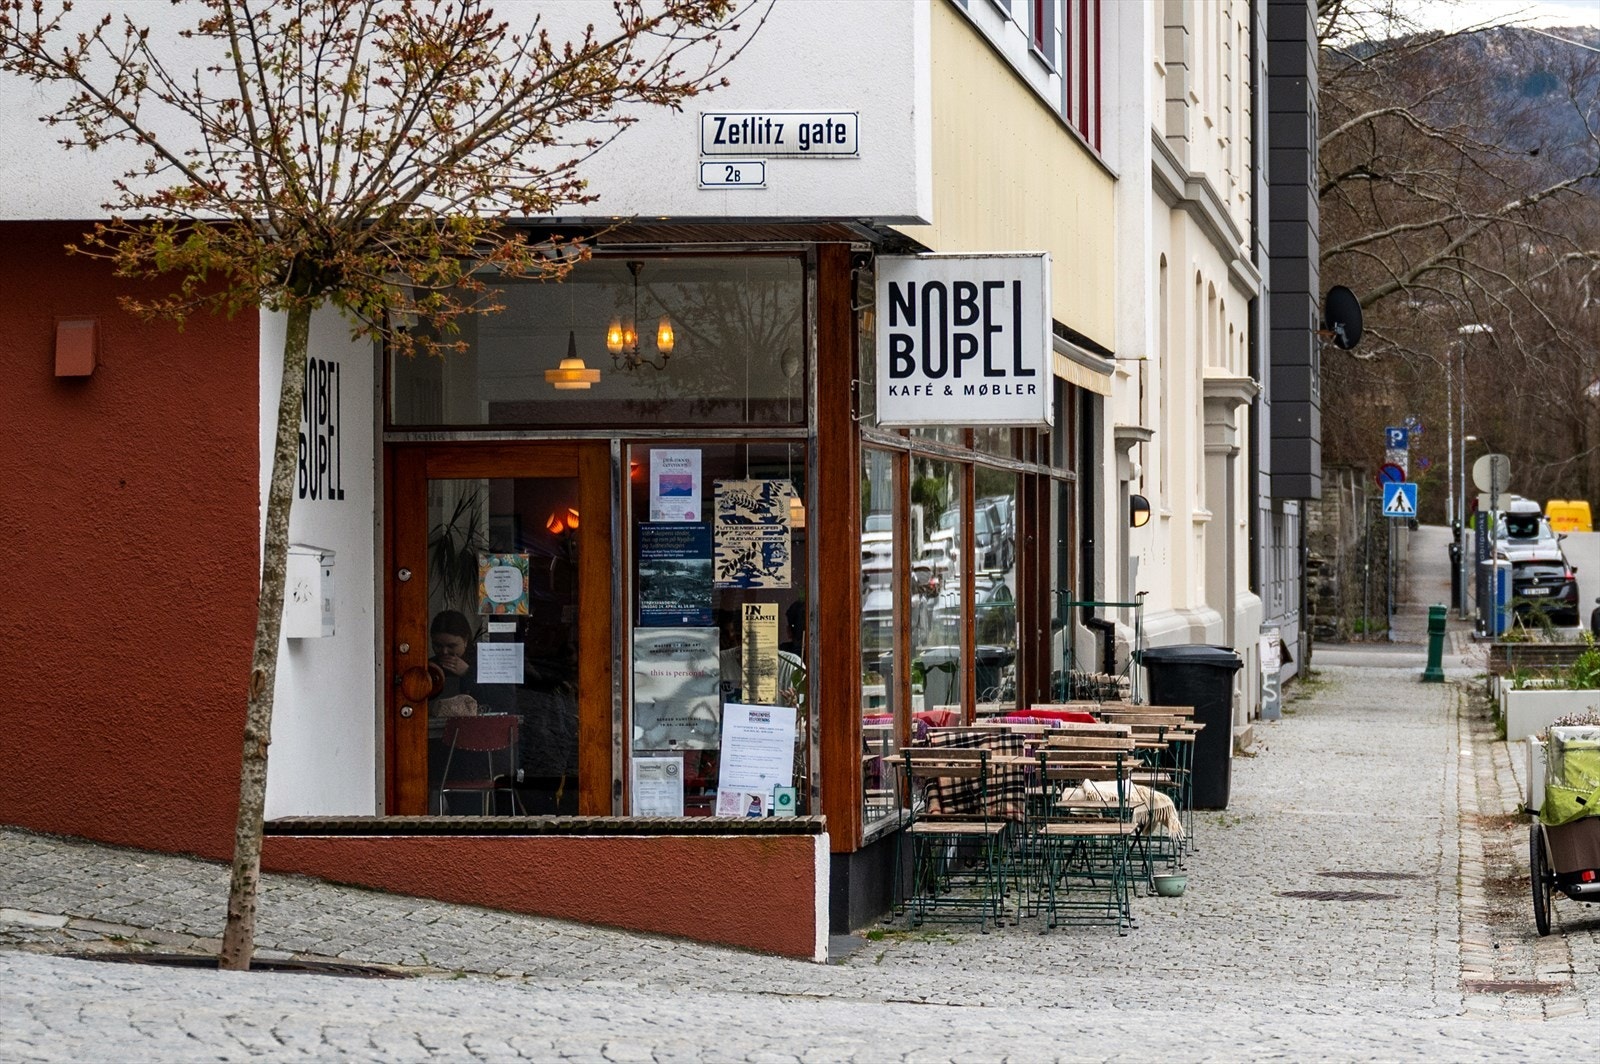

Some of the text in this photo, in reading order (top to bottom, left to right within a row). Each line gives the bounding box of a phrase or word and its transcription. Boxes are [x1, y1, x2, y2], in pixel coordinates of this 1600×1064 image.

[712, 116, 847, 151] Zetlitz gate
[725, 165, 741, 182] 2B
[888, 382, 1037, 396] KAFÉ & MØBLER
[745, 605, 762, 615] IN
[650, 669, 664, 677] this
[673, 670, 705, 678] personal
